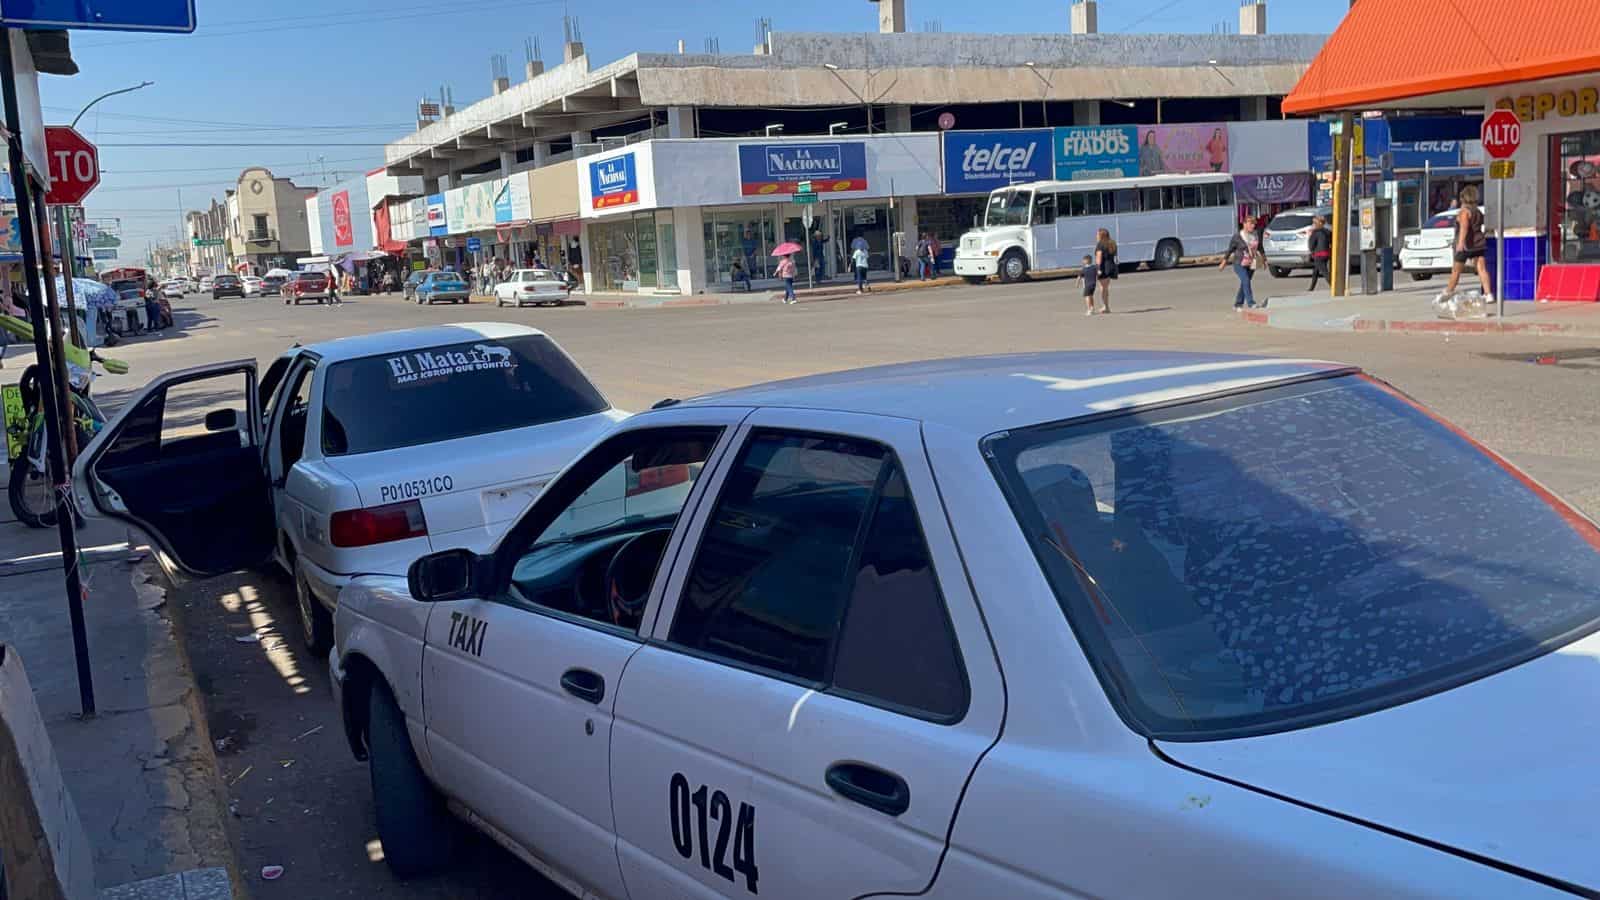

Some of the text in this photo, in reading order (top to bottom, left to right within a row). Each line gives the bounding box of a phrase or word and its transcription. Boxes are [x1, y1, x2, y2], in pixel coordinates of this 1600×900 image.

[1064, 135, 1130, 156] FIADOS
[1484, 124, 1520, 145] ALTO
[769, 153, 839, 171] NACIONAL
[797, 149, 811, 159] LA
[962, 142, 1037, 172] telcel
[50, 150, 94, 183] TO
[1256, 176, 1284, 190] MAS
[387, 351, 469, 376] El Mata
[398, 372, 418, 383] MAS
[455, 363, 475, 373] QUE
[381, 475, 453, 502] P010531CO
[448, 611, 488, 657] TAXI
[669, 772, 759, 895] 0124
